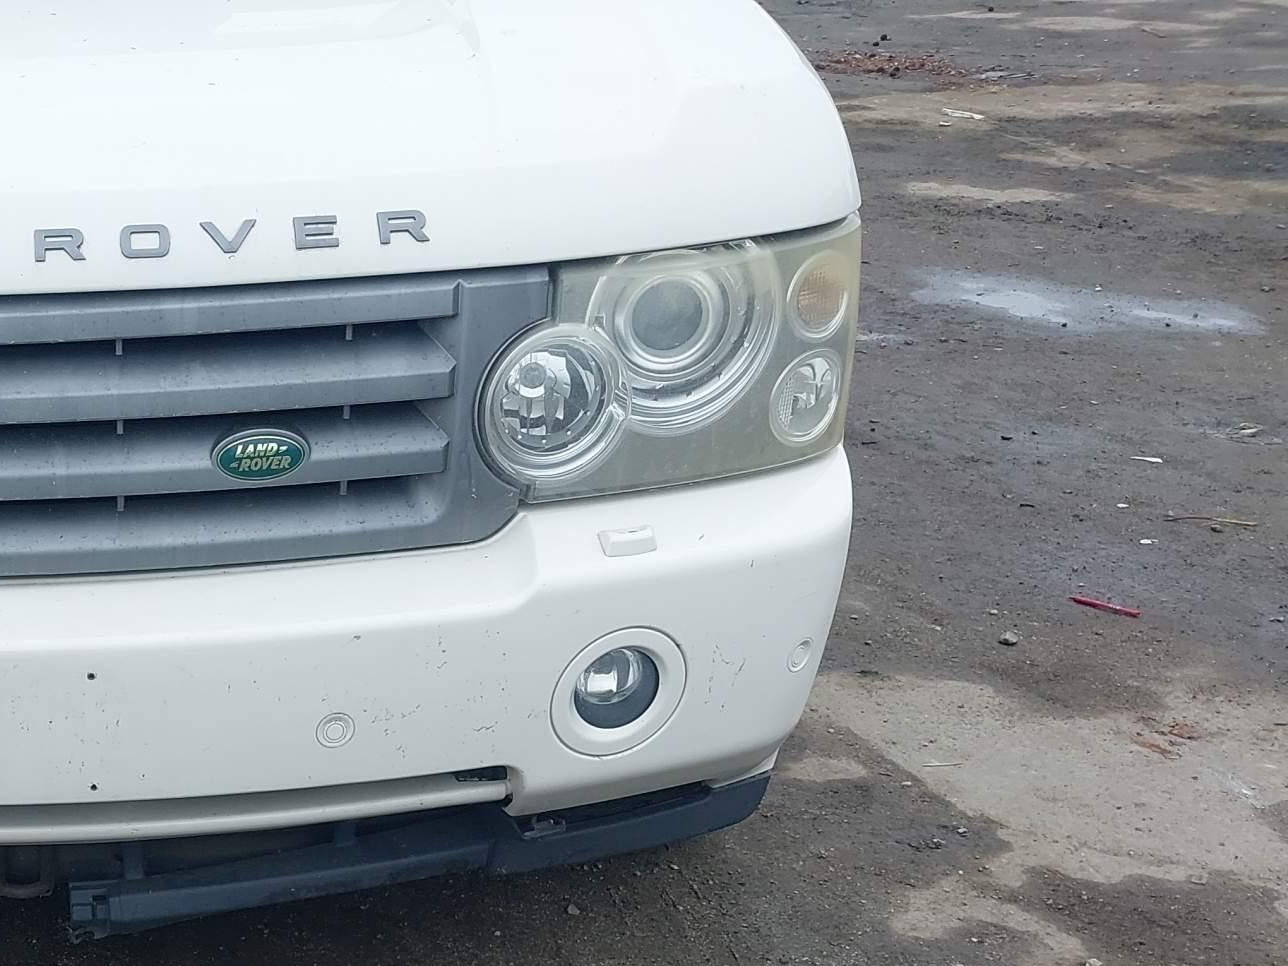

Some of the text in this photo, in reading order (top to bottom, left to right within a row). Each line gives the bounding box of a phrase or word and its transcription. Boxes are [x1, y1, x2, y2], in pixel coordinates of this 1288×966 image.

[32, 208, 432, 262] ROVER
[234, 442, 279, 459] LAND
[238, 455, 292, 472] ROVER
